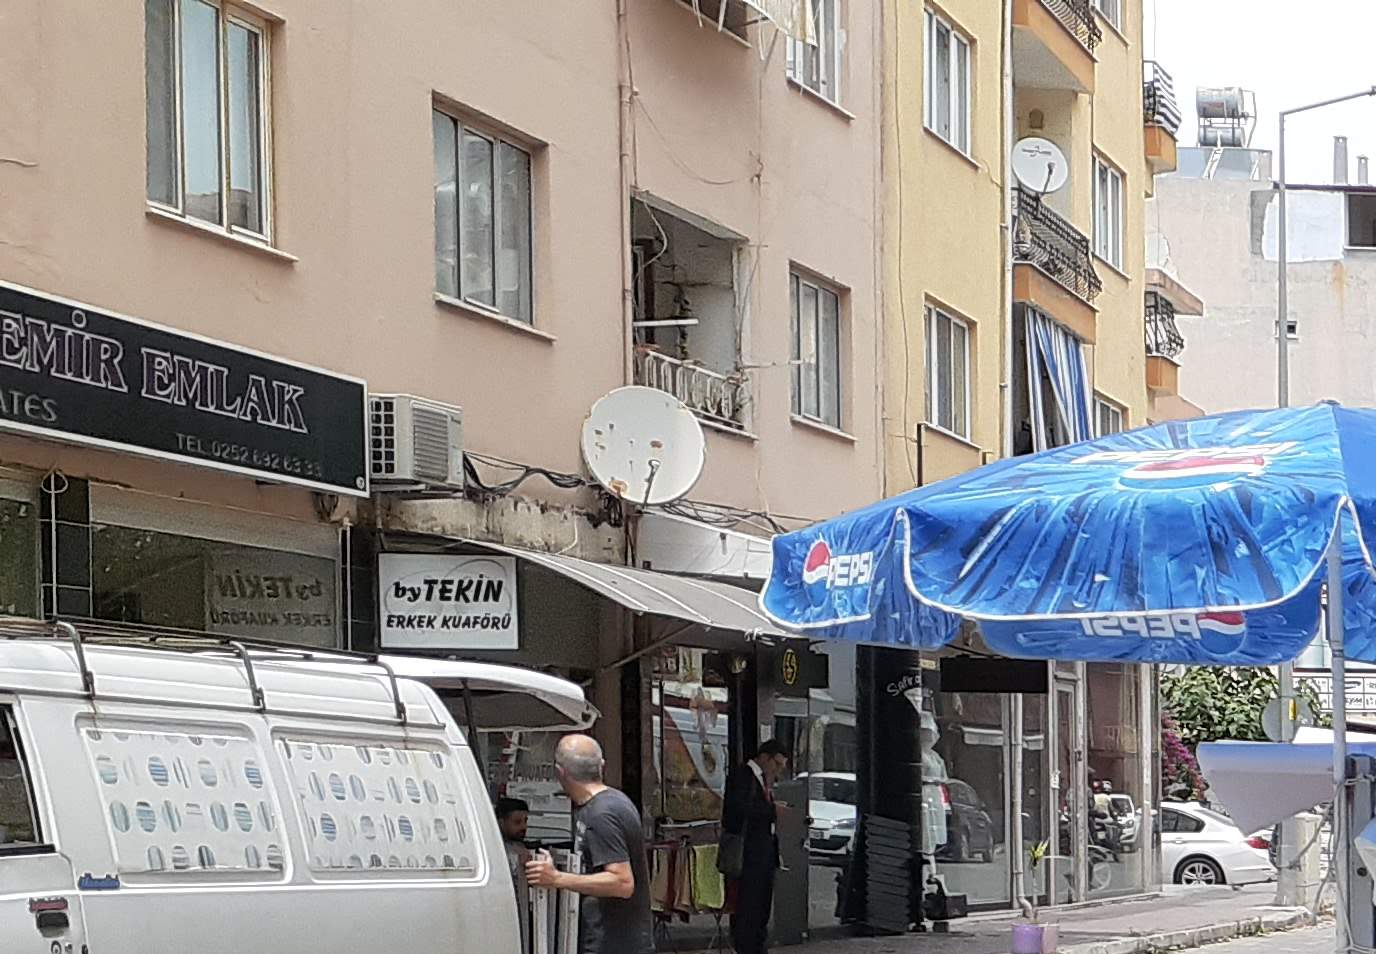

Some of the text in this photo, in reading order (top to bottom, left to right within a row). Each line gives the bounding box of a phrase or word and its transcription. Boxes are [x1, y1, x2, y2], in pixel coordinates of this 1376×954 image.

[141, 347, 308, 434] EMLAK
[826, 551, 874, 589] PEPSI
[386, 611, 511, 631] ERKEK KUAFÖRÜ
